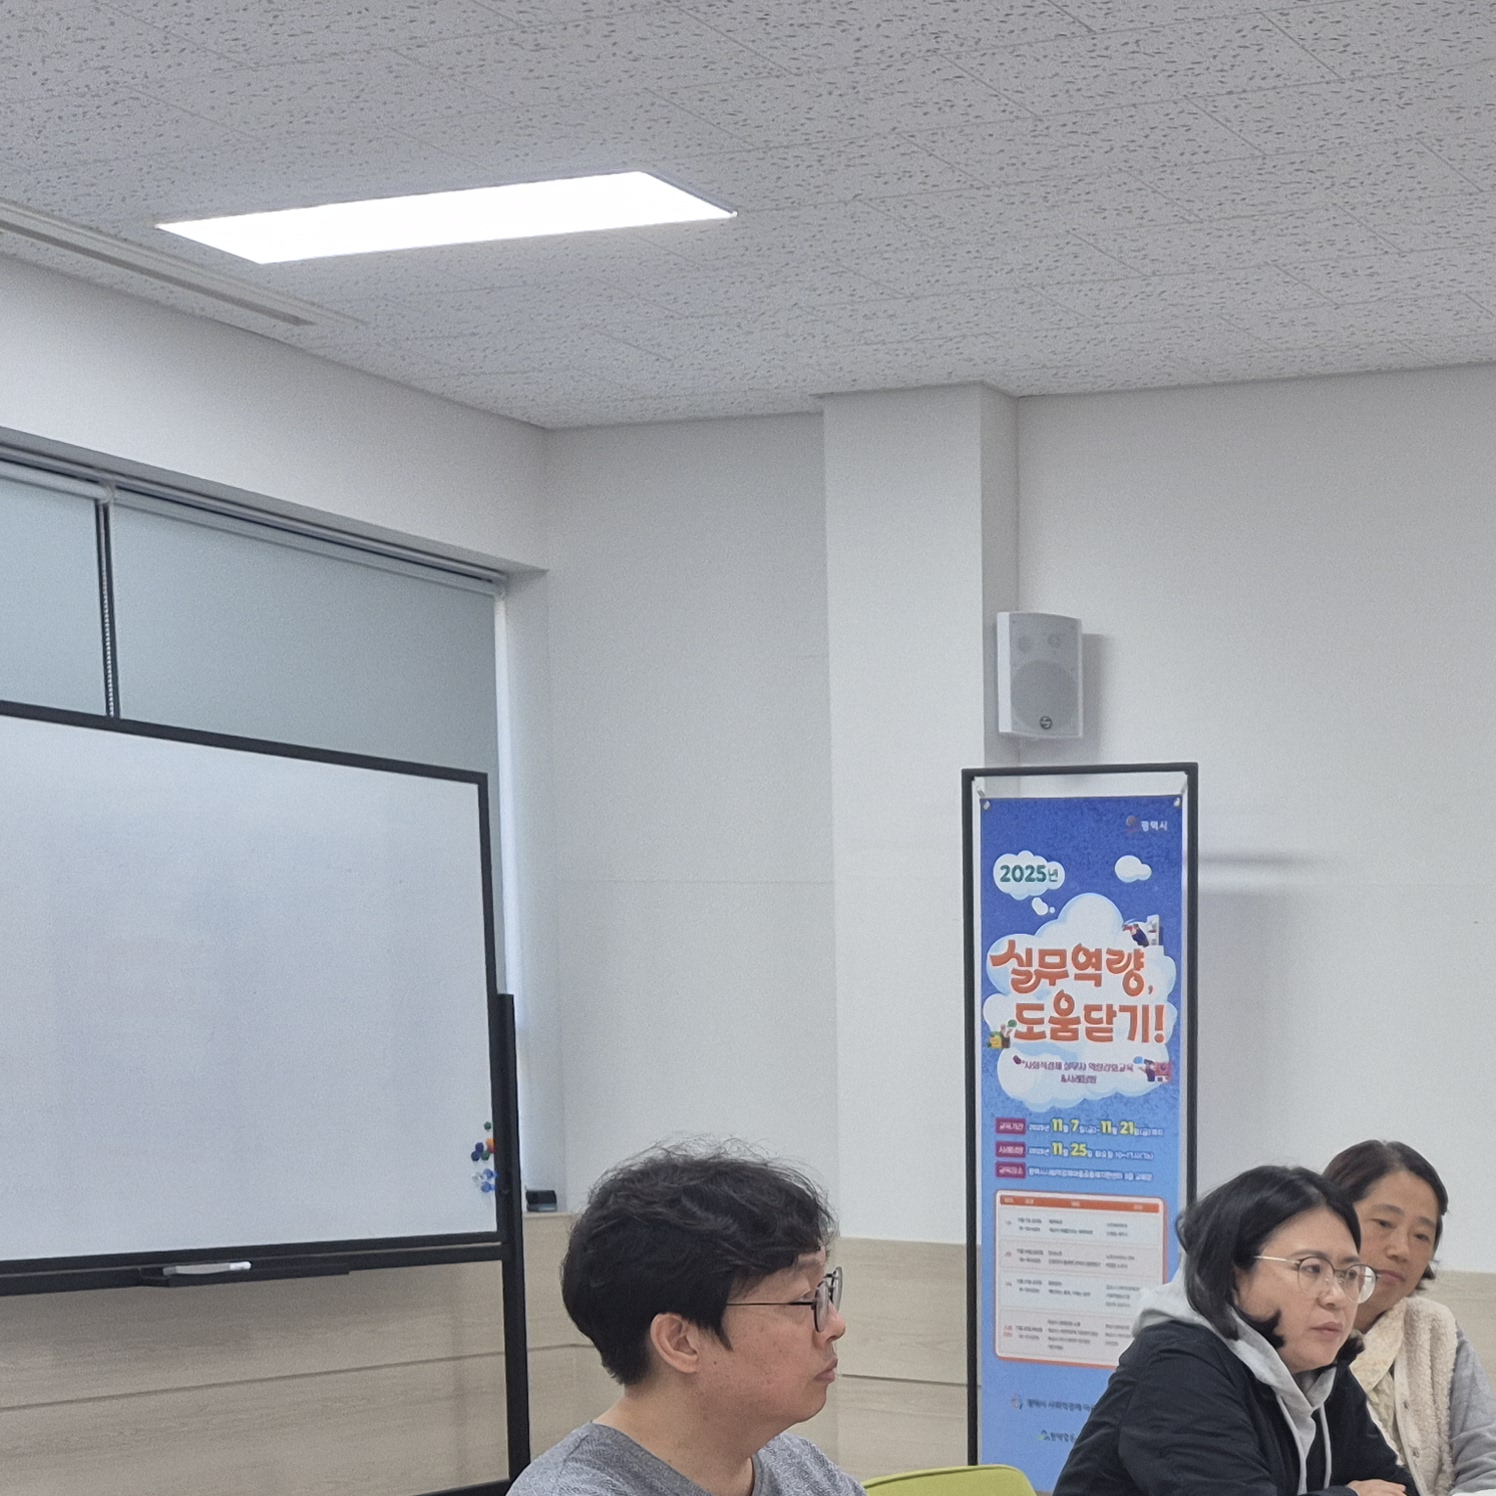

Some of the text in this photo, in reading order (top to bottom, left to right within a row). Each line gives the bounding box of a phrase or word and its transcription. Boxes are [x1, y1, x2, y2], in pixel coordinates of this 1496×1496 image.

[1000, 864, 1059, 883] 2025년
[990, 939, 1153, 995] 실무역량,
[1013, 990, 1166, 1043] 도움닫기!
